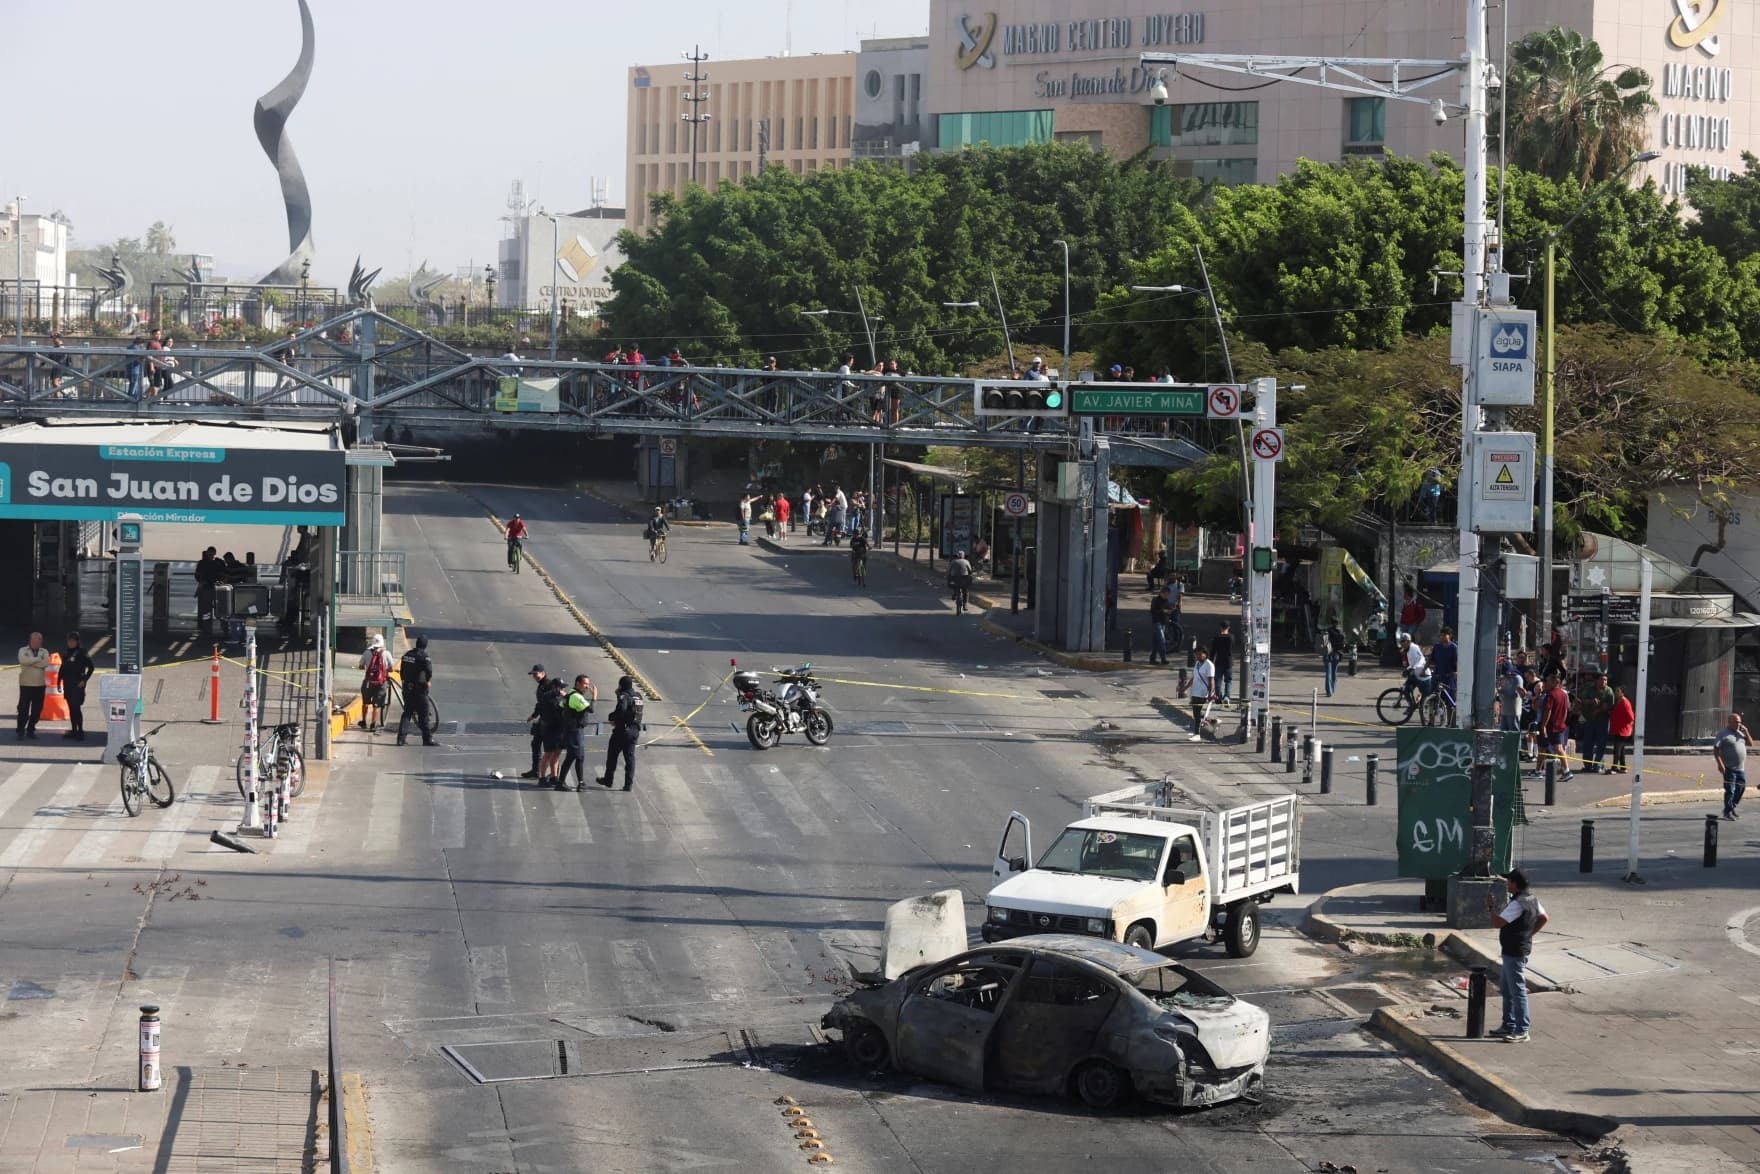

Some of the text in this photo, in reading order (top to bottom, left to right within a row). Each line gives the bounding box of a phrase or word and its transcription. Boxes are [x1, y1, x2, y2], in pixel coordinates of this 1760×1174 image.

[1003, 12, 1204, 55] MAGNO CENTRO JOYERO
[1036, 70, 1064, 97] San
[1070, 72, 1108, 99] Juan
[1666, 63, 1732, 101] MAGNO
[1665, 112, 1730, 150] CENTRO
[1496, 337, 1521, 347] agua
[1492, 362, 1522, 372] SIAPA
[1082, 395, 1193, 409] AV. JAVIER MINA
[108, 447, 216, 460] Estación Express
[27, 470, 338, 503] San Juan de Dios
[1010, 498, 1022, 507] 50
[117, 511, 206, 522] Dción Mirador
